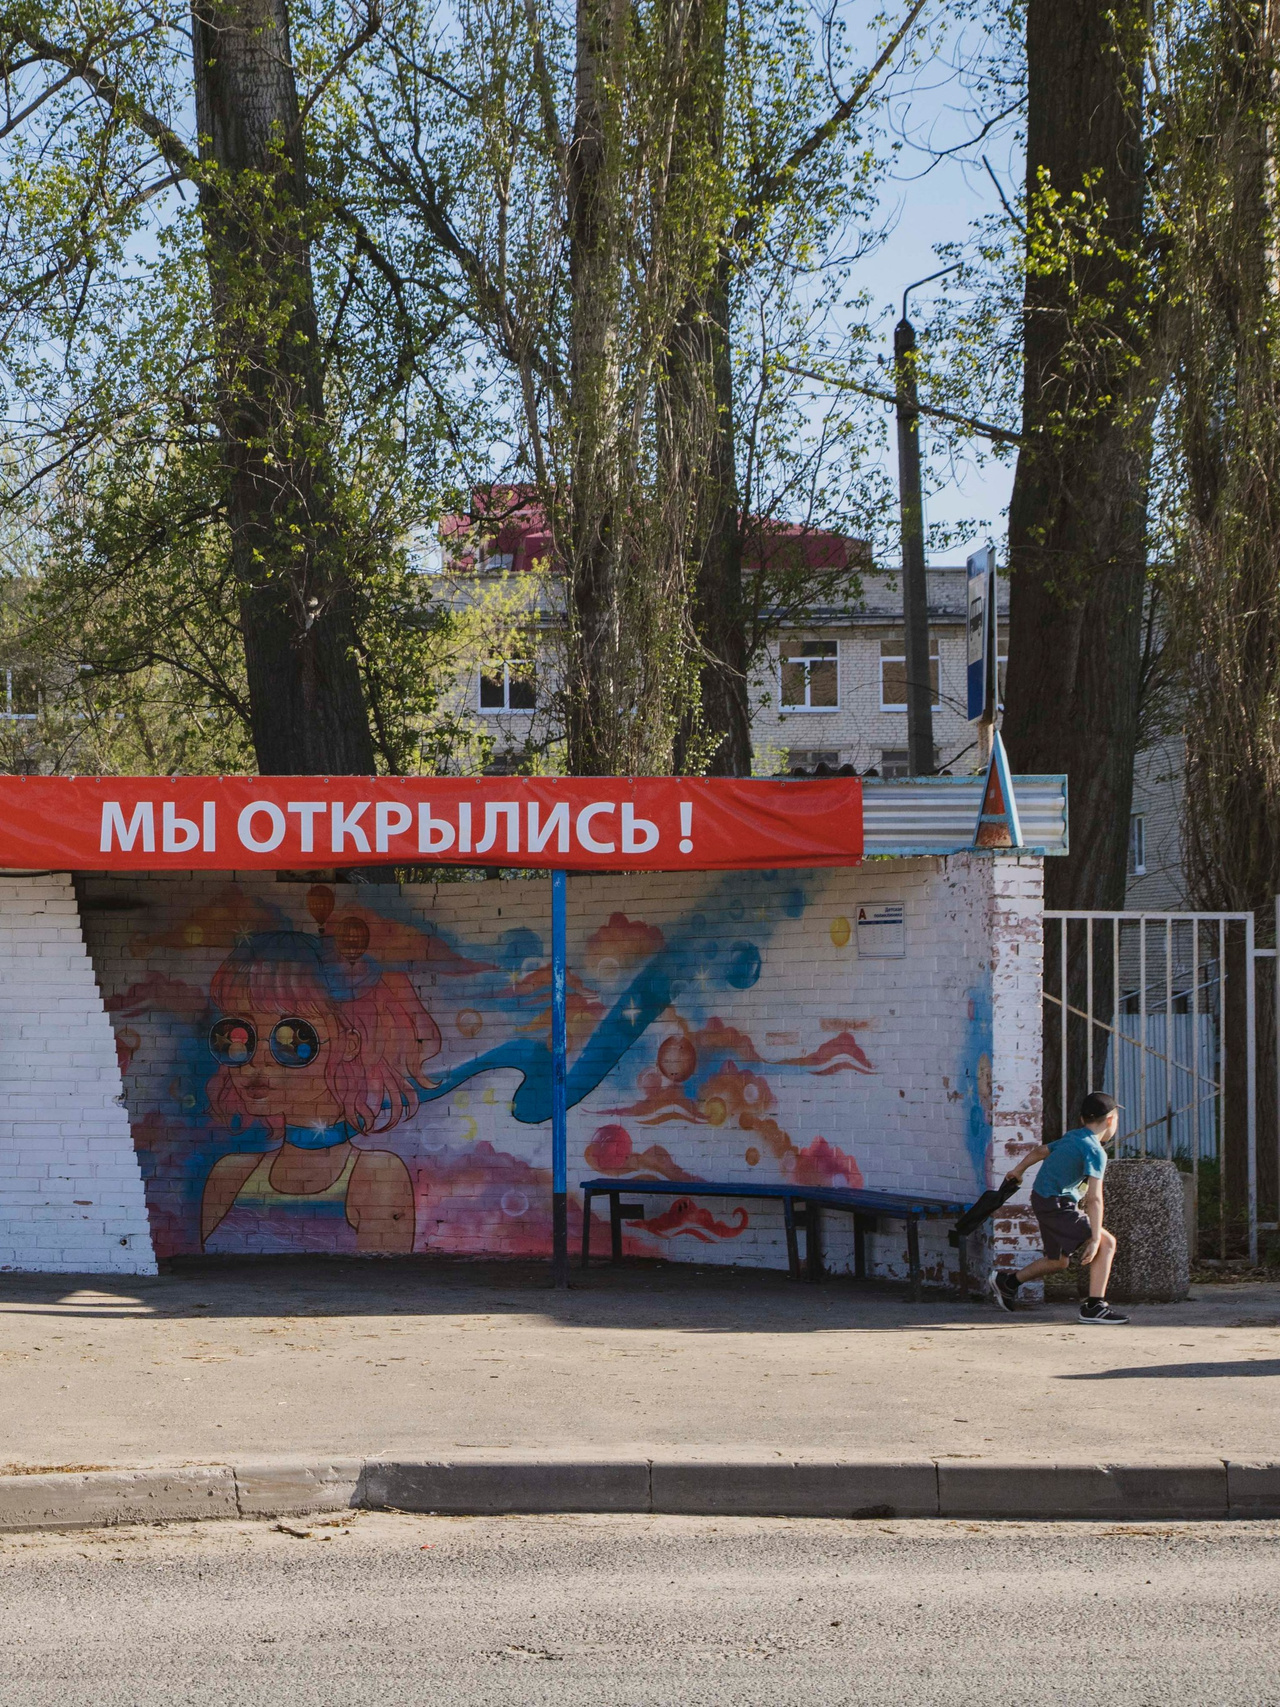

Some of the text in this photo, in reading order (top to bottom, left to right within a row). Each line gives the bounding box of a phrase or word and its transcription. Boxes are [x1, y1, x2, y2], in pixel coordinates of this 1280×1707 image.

[99, 801, 694, 854] МЫ ОТКРЫЛИСЬ !
